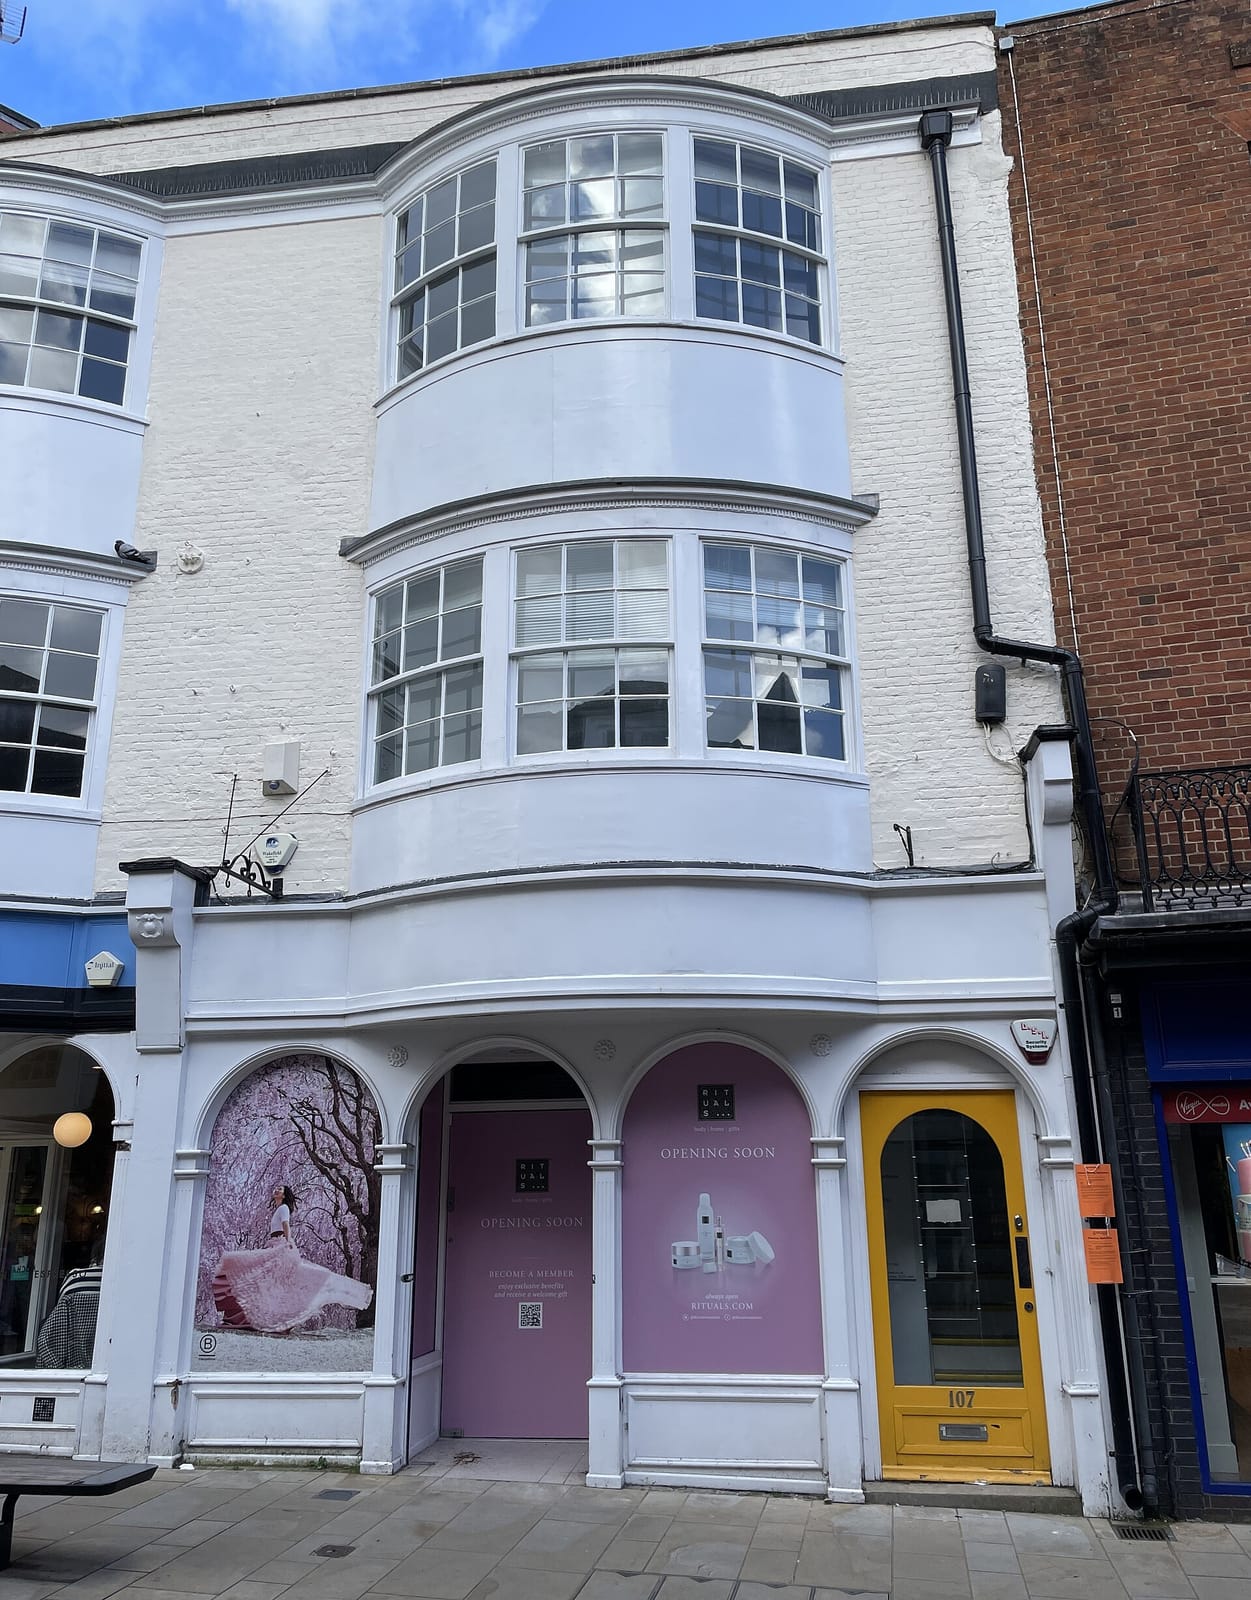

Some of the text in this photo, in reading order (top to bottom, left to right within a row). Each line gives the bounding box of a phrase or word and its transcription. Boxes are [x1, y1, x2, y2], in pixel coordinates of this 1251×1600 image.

[1180, 1096, 1202, 1115] Virgin
[660, 1146, 775, 1159] OPENING SOON
[480, 1216, 583, 1229] OPENING SOON
[489, 1270, 526, 1278] BECOME
[536, 1269, 575, 1278] MEMBER
[541, 1281, 564, 1290] benefits
[691, 1302, 753, 1310] RITUALS.COM
[949, 1390, 975, 1408] 107
